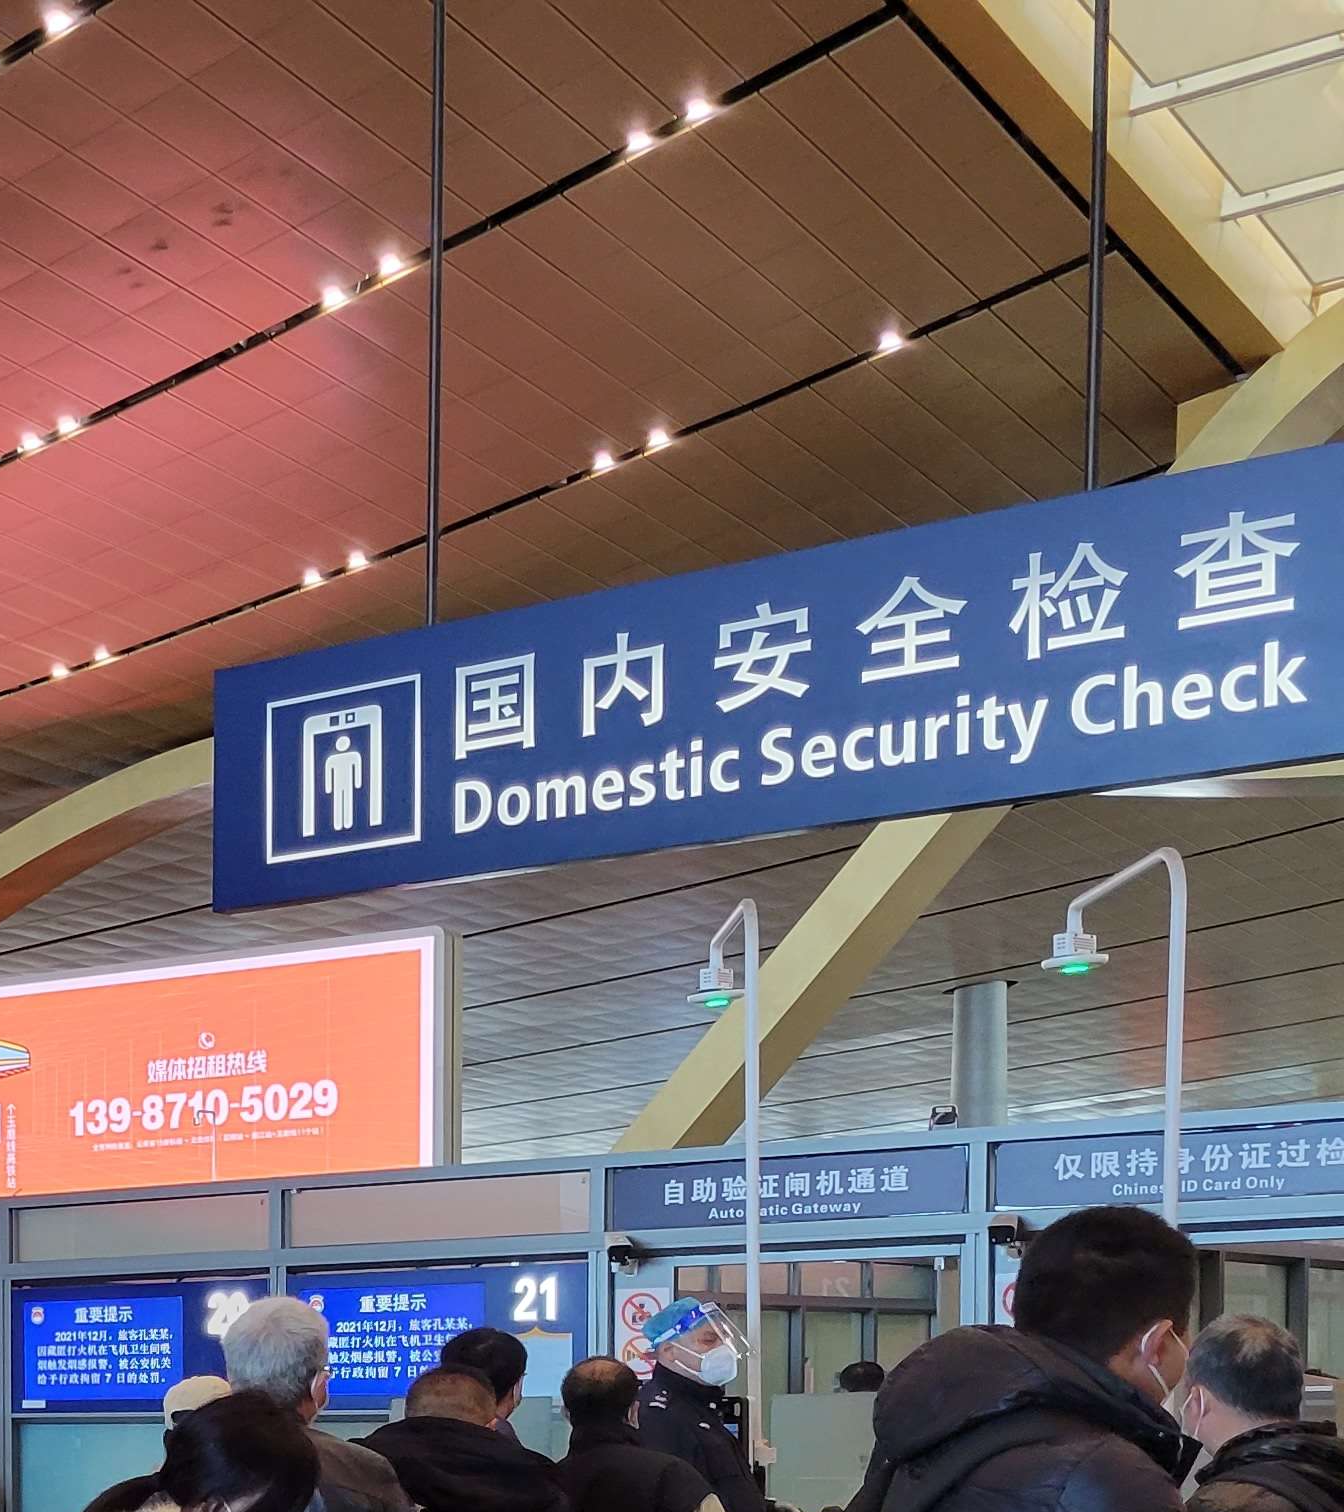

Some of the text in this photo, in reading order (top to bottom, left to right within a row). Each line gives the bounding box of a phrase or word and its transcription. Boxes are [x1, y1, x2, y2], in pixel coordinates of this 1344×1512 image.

[453, 511, 1299, 760] 国内安全检查
[454, 642, 1308, 836] Domestic Security Check
[147, 1050, 267, 1083] 媒体招租热线
[70, 1080, 338, 1136] 139-8710-5029
[1180, 1174, 1284, 1193] ID Card Only
[708, 1200, 861, 1220] Autoatic Gateway
[74, 1305, 133, 1324] 重要提示
[359, 1294, 427, 1313] 重要提示
[513, 1275, 557, 1322] 21
